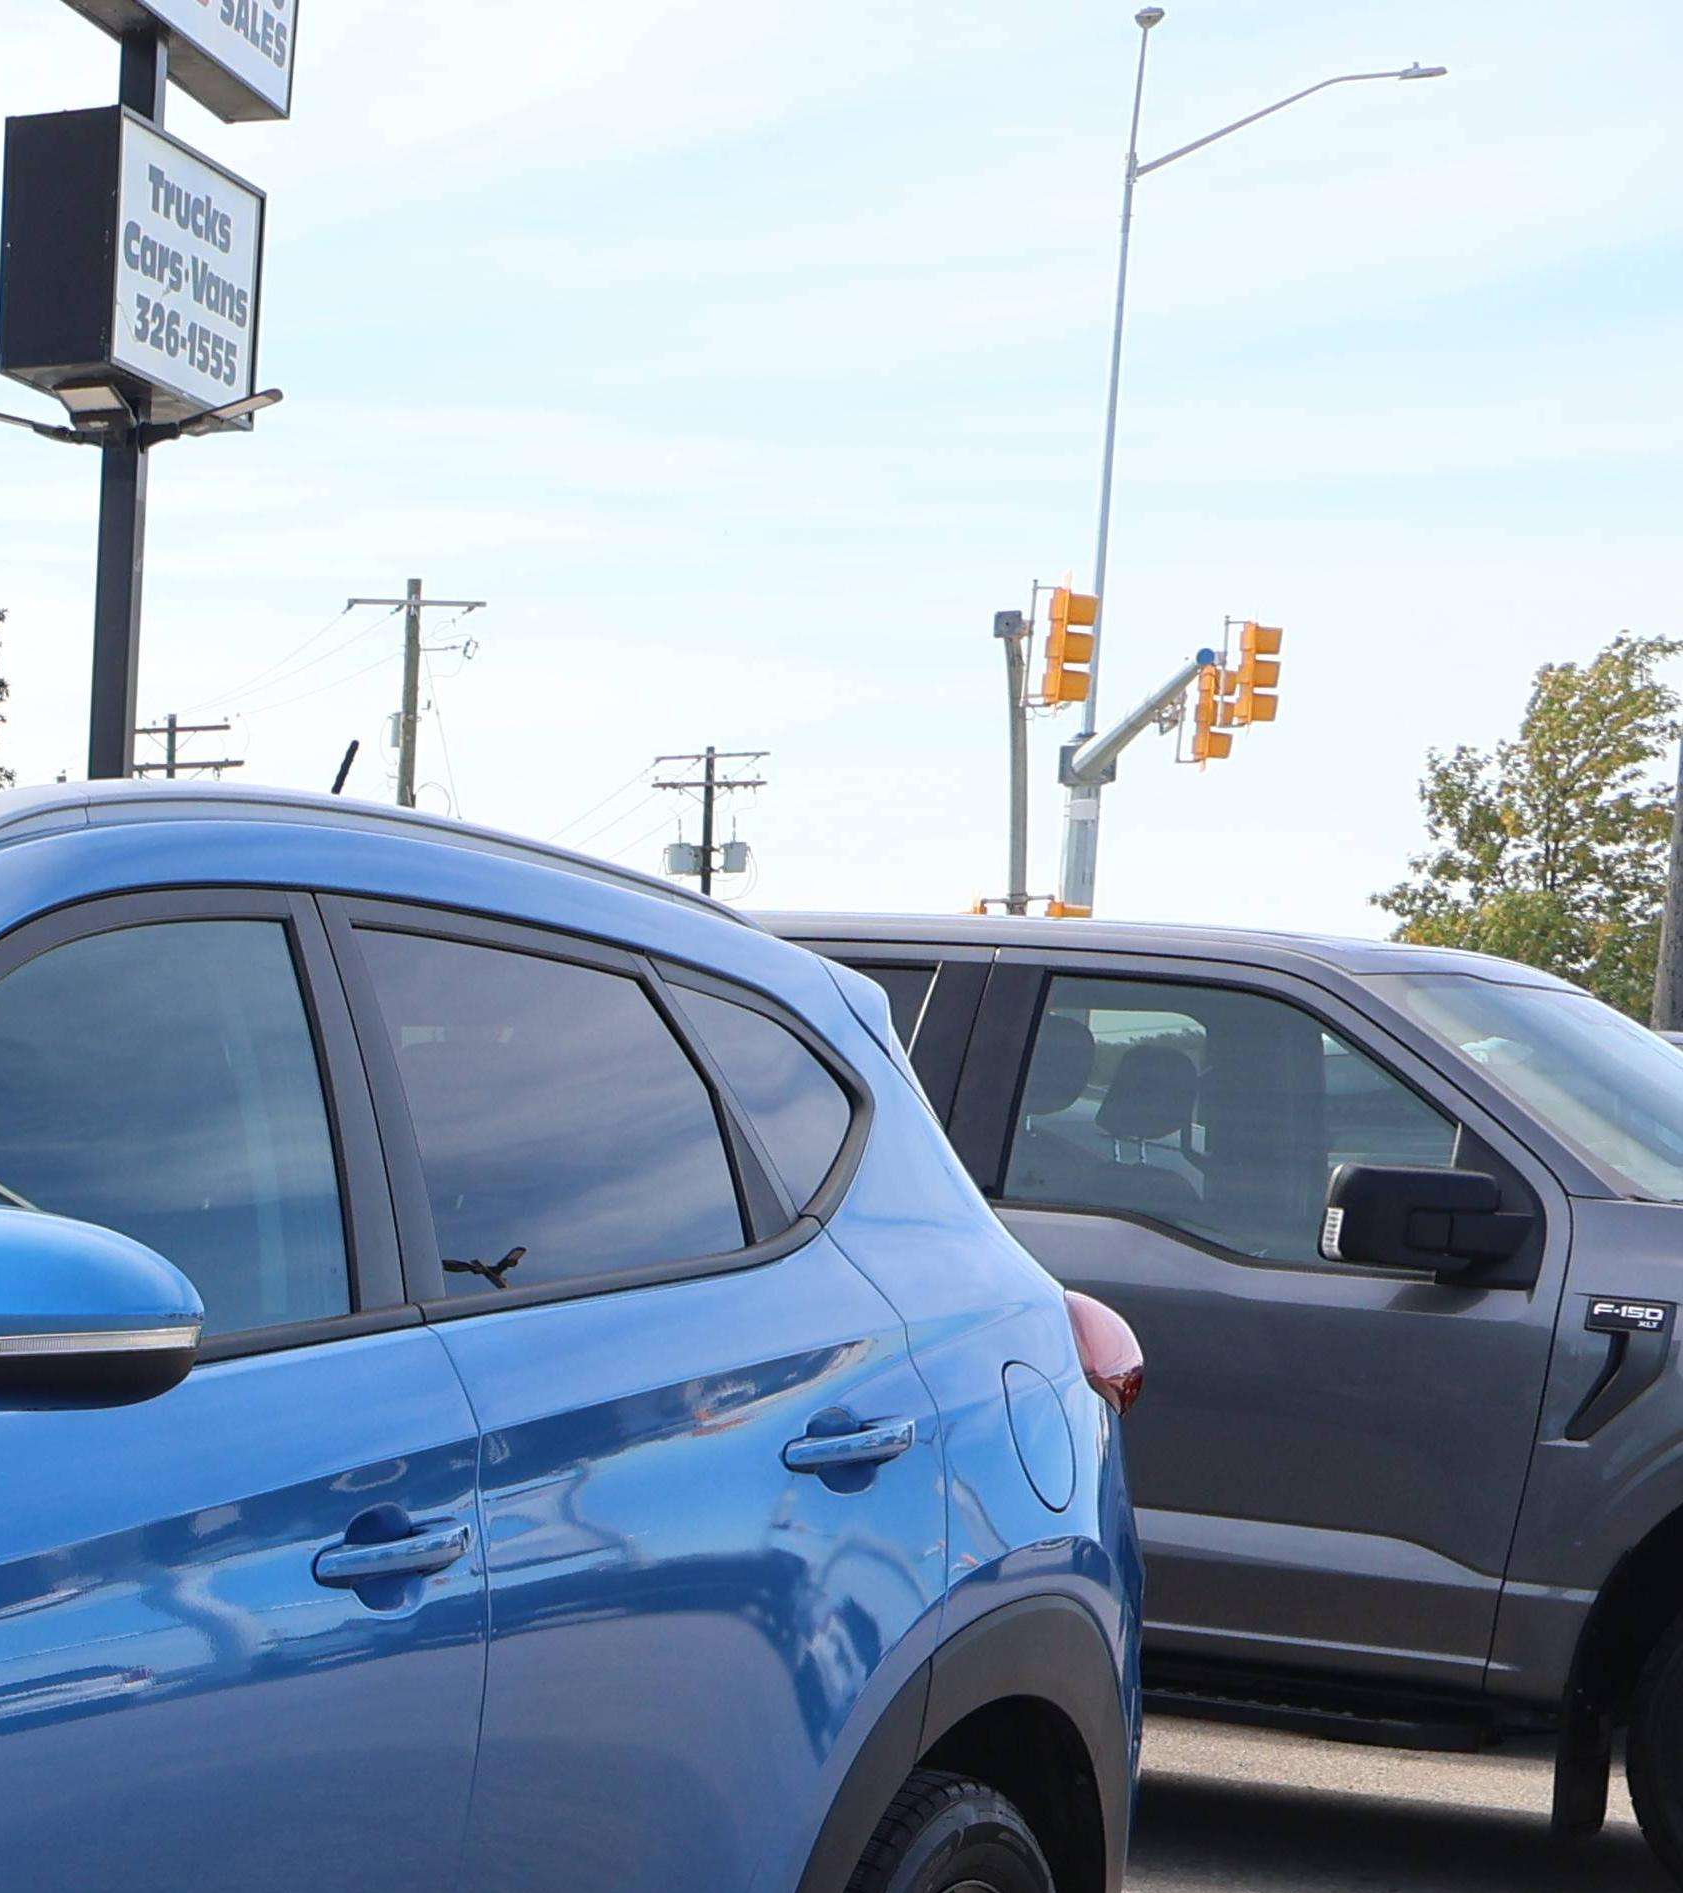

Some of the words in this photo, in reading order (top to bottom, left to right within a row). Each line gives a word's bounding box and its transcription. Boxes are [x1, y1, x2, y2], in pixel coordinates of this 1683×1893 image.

[149, 164, 232, 253] Trucks
[135, 293, 237, 386] 326-1555
[1593, 1303, 1663, 1320] F-150
[1638, 1321, 1658, 1329] XLT
